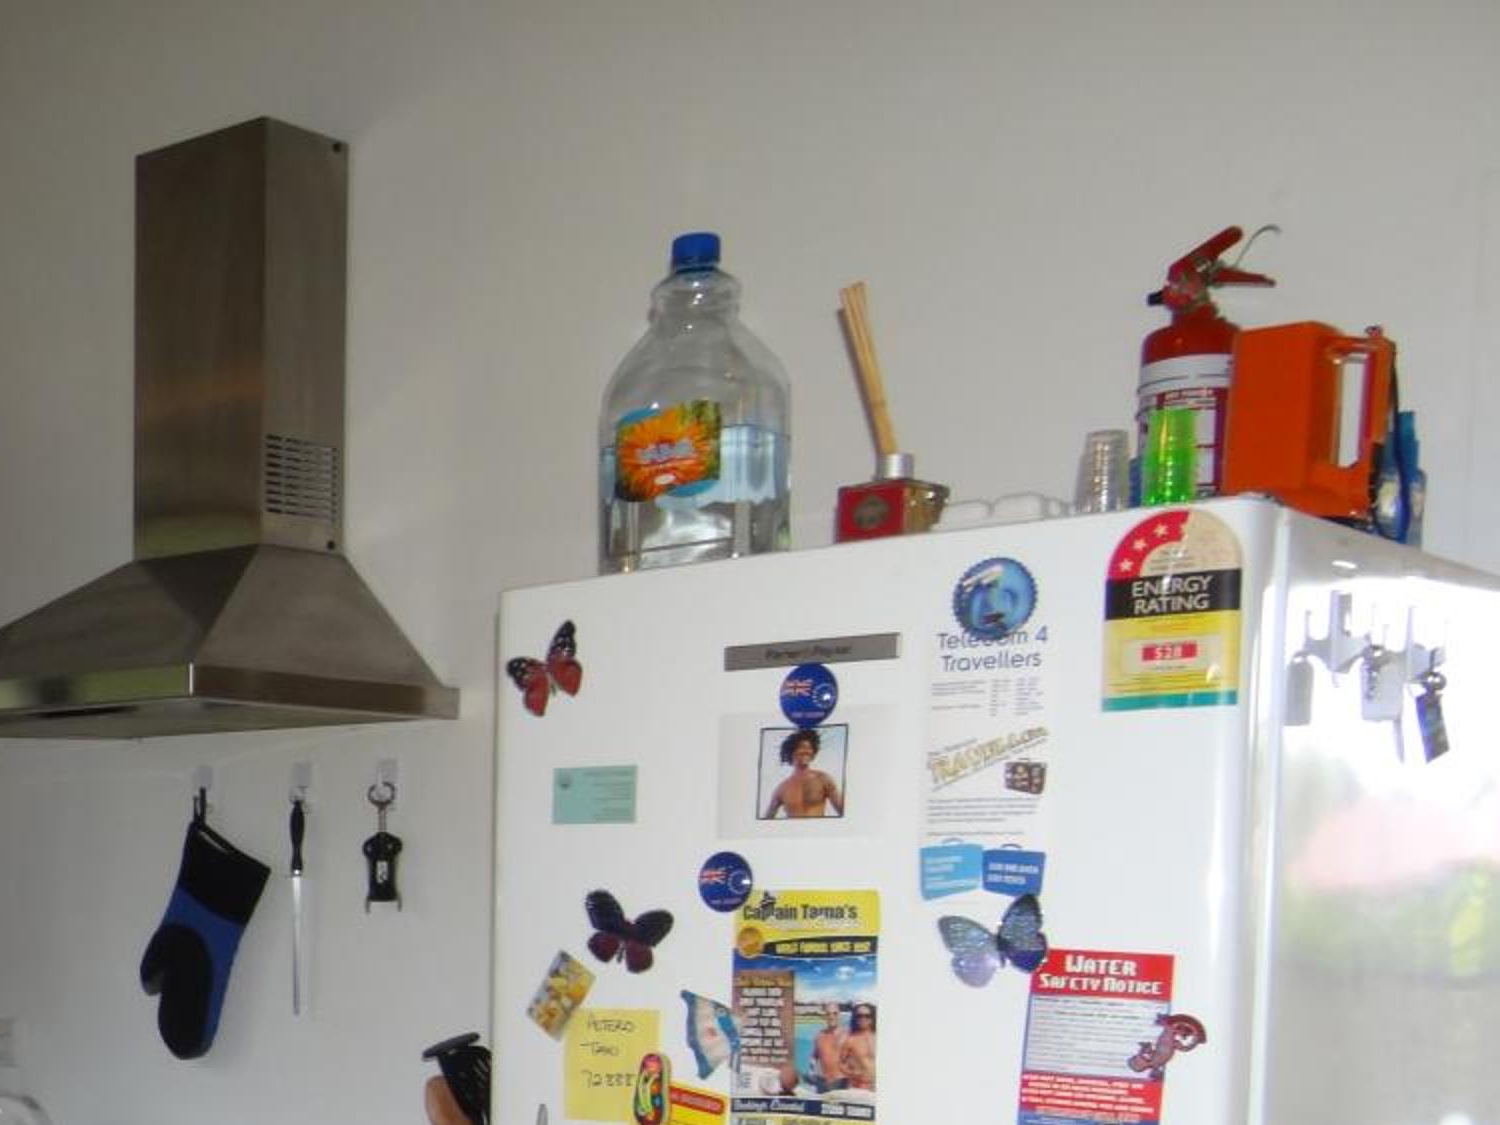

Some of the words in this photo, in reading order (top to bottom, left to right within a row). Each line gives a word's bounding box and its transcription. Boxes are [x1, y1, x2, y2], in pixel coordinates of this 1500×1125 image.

[1131, 575, 1213, 597] ENERGY
[1133, 593, 1210, 615] RATING
[1034, 624, 1048, 645] 4
[941, 651, 1042, 673] Travellers
